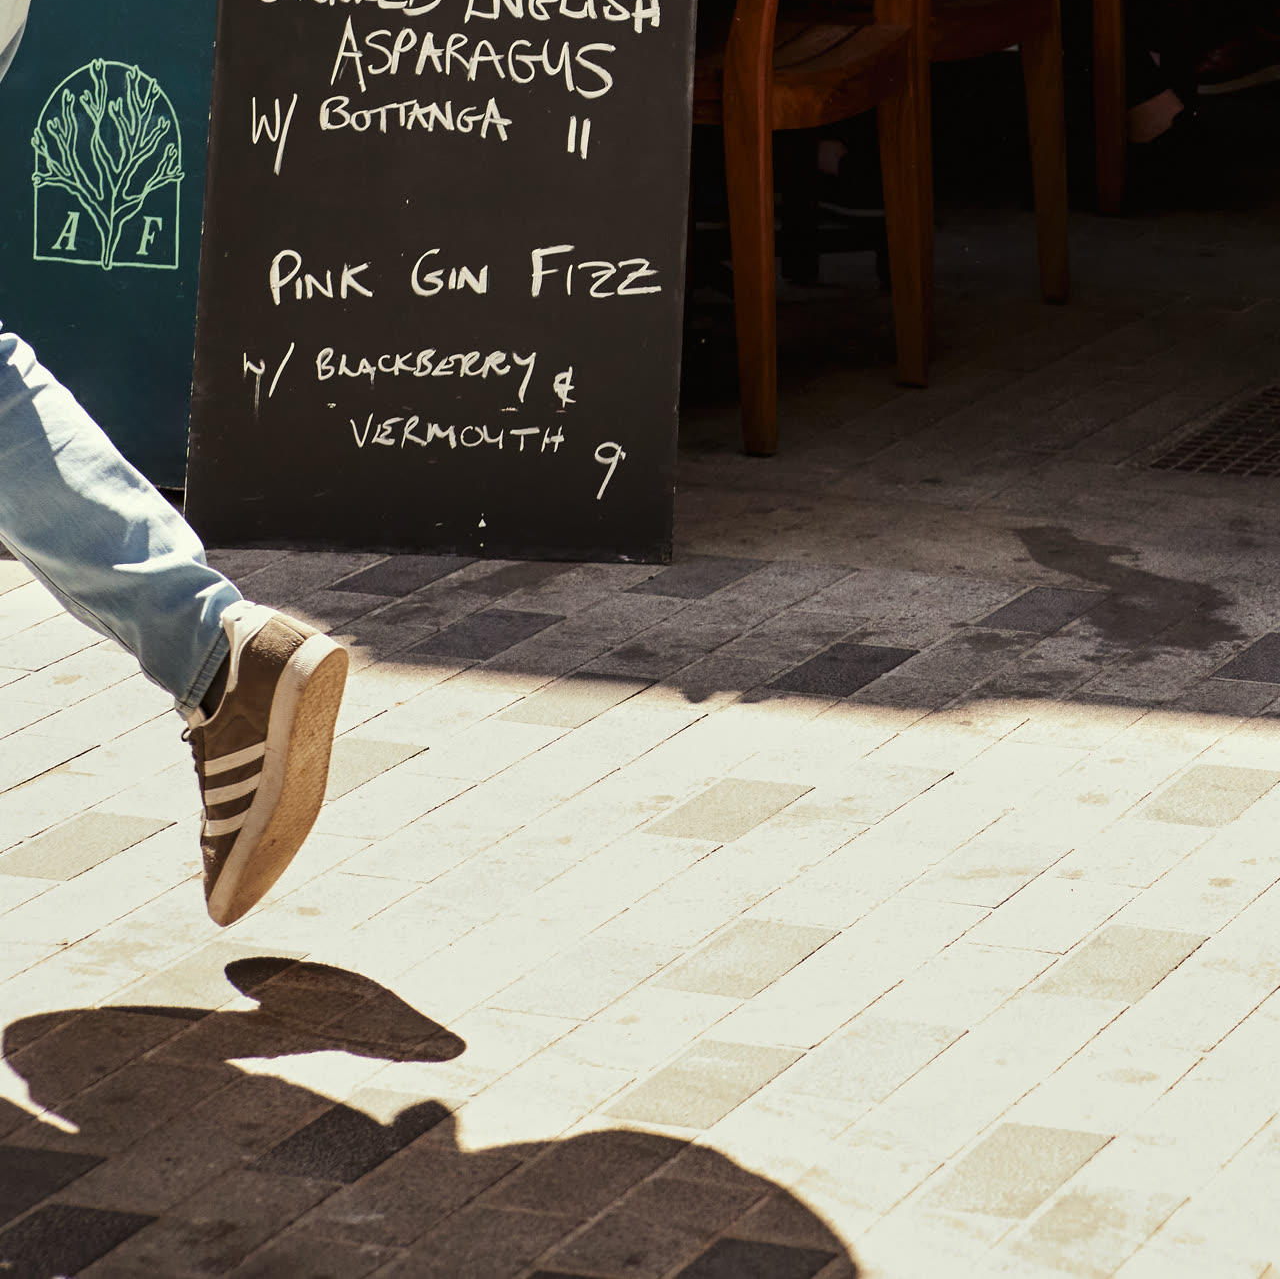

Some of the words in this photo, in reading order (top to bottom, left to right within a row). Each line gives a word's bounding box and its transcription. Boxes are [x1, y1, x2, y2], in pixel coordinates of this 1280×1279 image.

[331, 15, 617, 99] ASPARAGUS
[51, 210, 80, 253] A
[135, 215, 163, 257] F
[269, 249, 373, 305] PINK
[411, 248, 489, 297] GIN
[531, 244, 662, 298] FIZZ
[315, 347, 537, 404] BLACKBERRY
[349, 412, 565, 453] VERMOUTH
